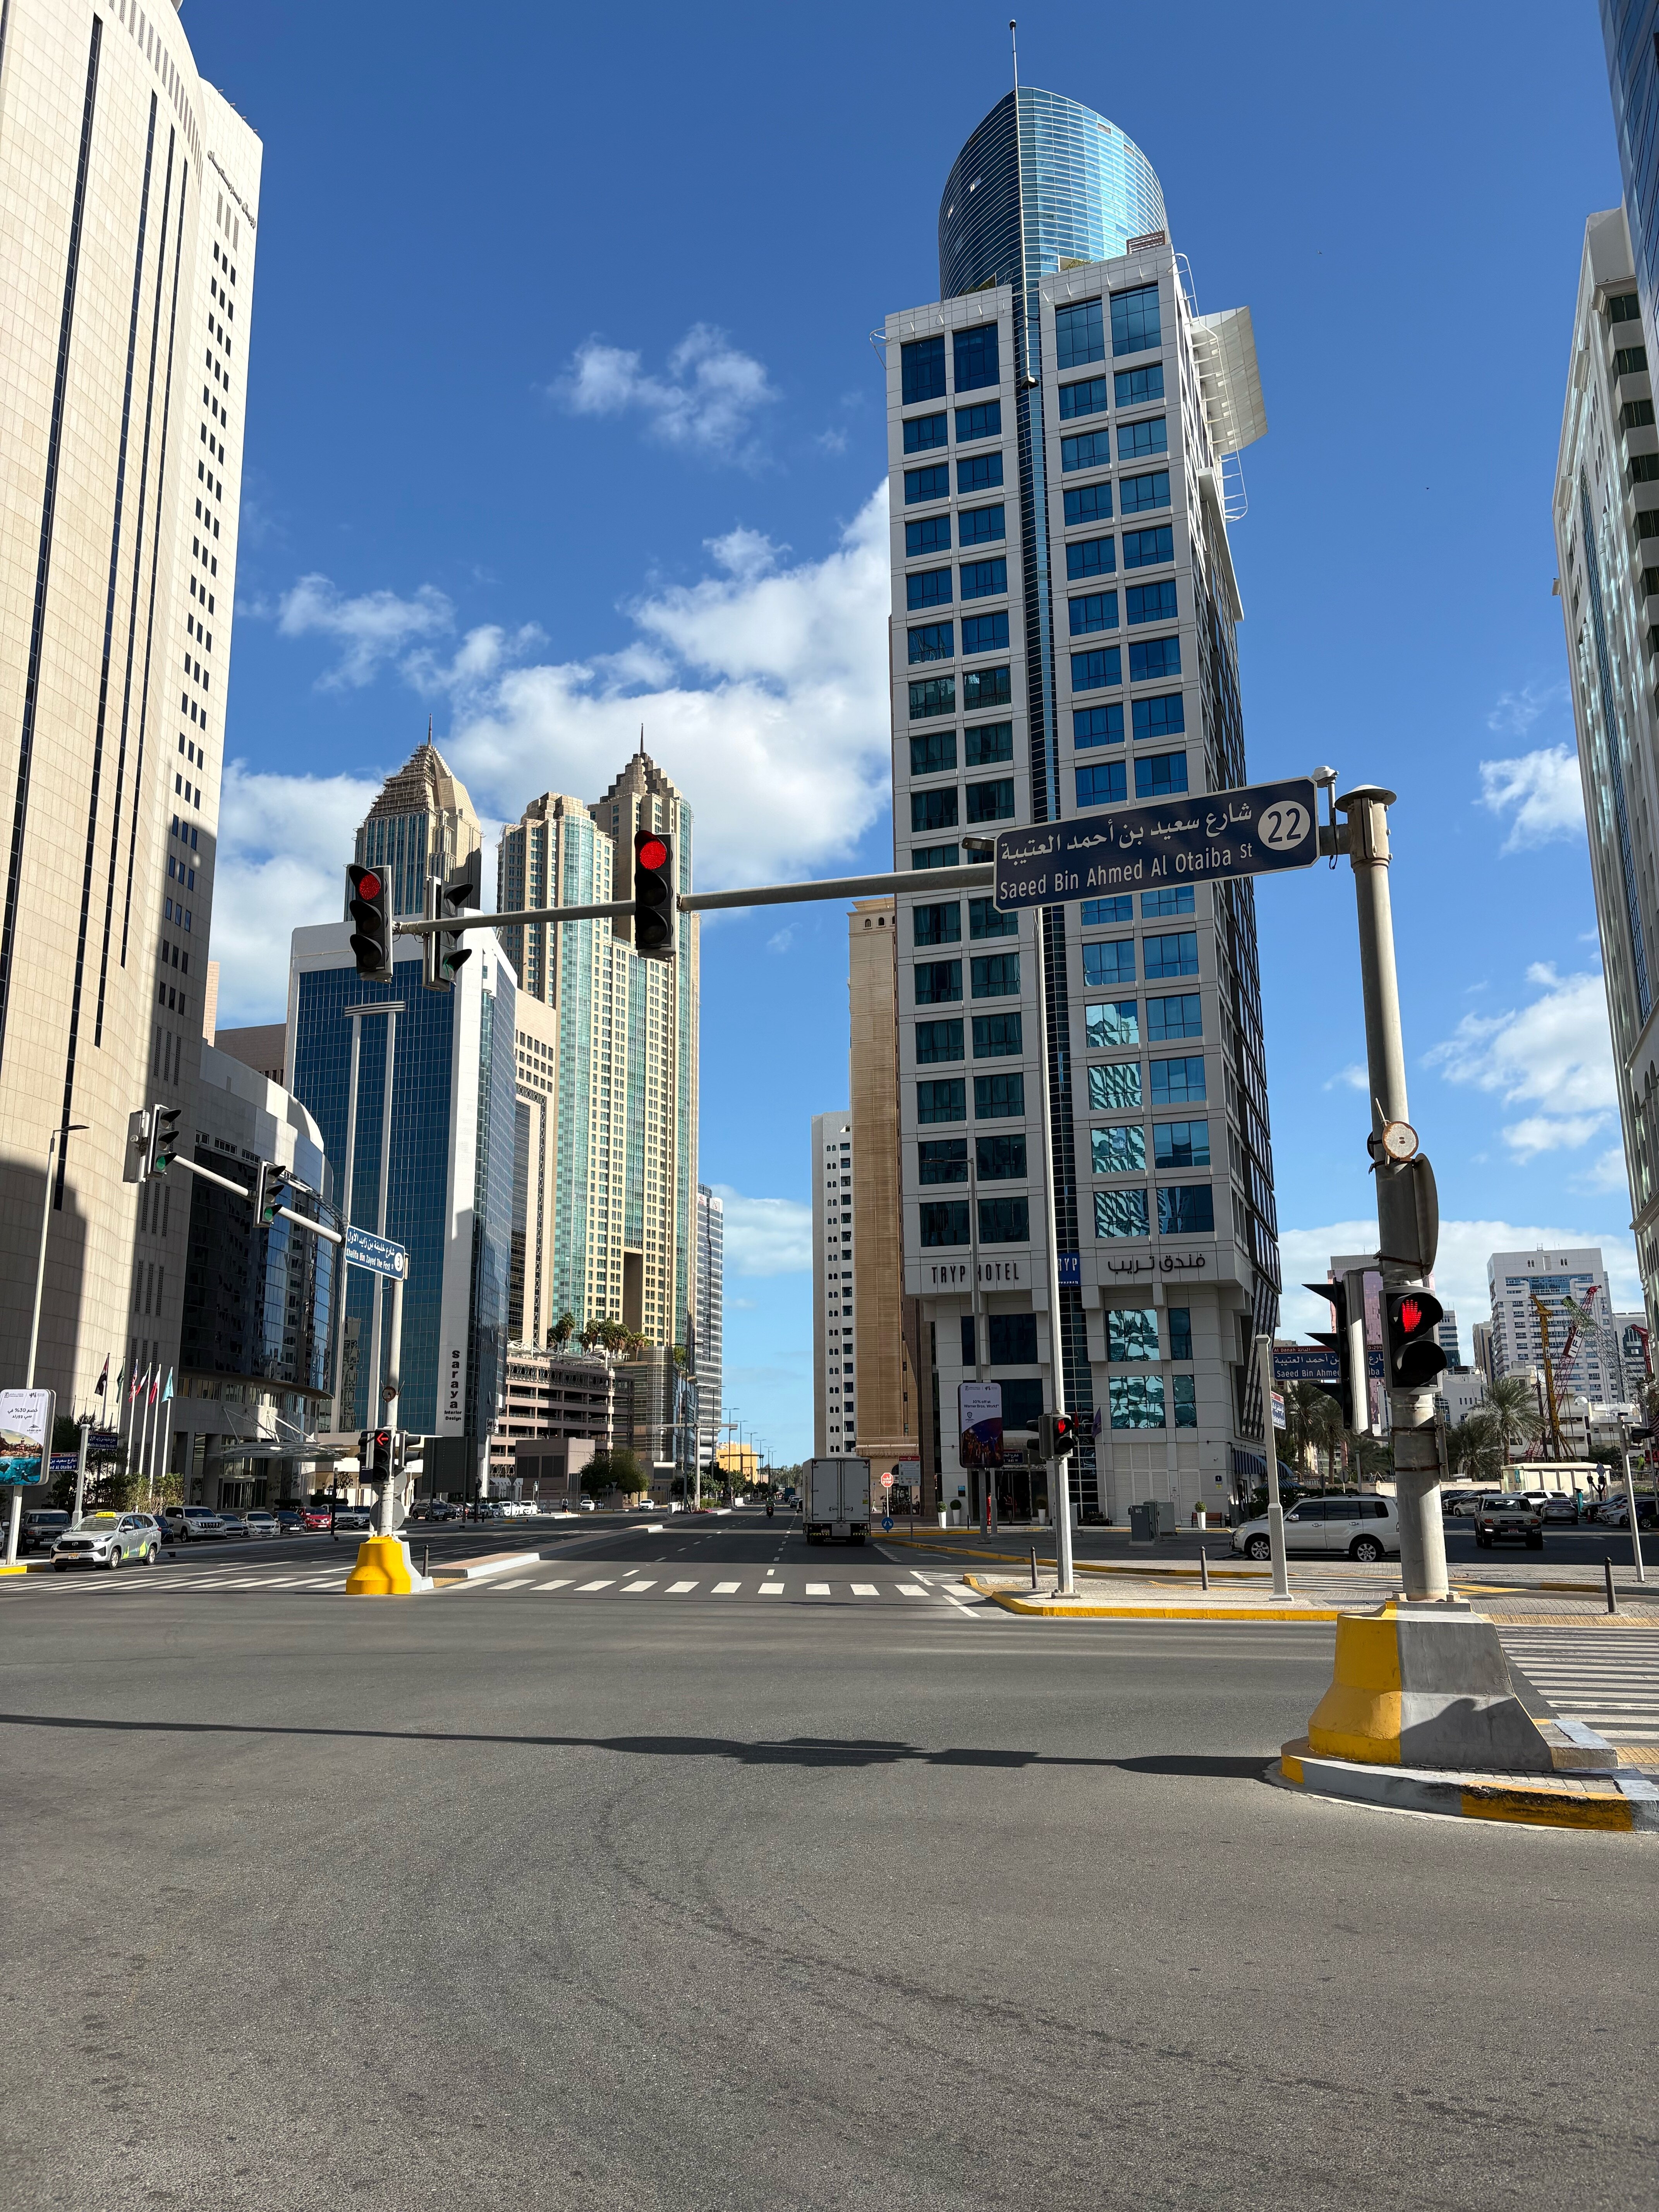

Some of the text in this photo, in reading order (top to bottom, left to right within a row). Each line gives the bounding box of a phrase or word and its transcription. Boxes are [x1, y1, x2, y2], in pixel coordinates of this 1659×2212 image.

[1267, 808, 1301, 843] 22
[1001, 802, 1252, 866] شارع سعيد بن أحمد العتيبة
[1000, 843, 1252, 900] Saeed Bin Ahmed Al Otaiba St
[368, 1240, 373, 1251] بن
[386, 1246, 395, 1258] شارع
[397, 1256, 400, 1268] 3
[1058, 1258, 1077, 1271] RYP
[1108, 1254, 1205, 1274] فندق تريب
[931, 1265, 965, 1283] TRYP
[1274, 1356, 1303, 1366] العتيبة
[1306, 1353, 1328, 1363] أحمد
[1369, 1353, 1384, 1365] ارع
